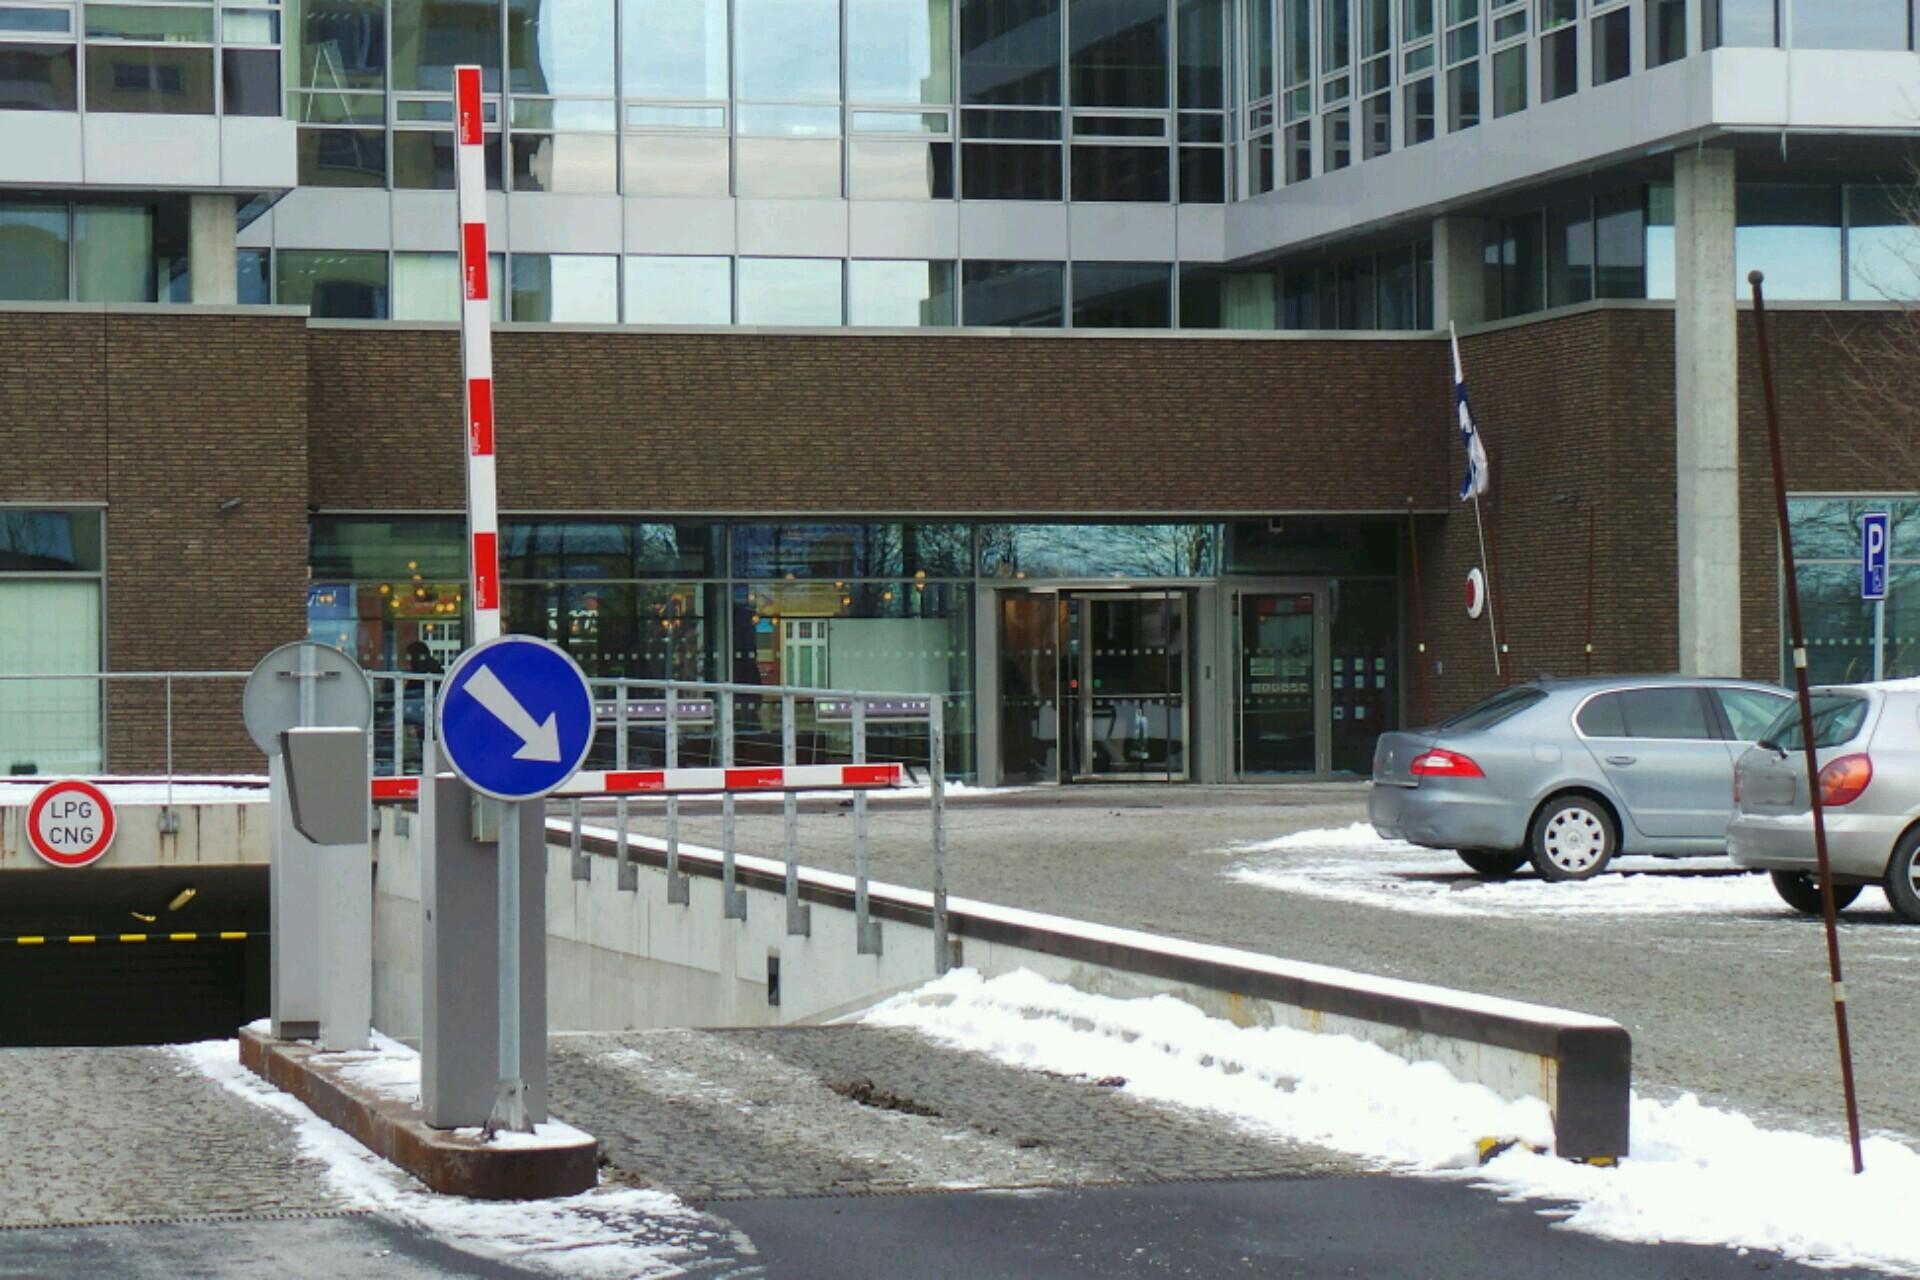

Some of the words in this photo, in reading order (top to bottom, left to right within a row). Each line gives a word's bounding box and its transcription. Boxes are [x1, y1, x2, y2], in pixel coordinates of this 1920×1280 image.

[1868, 523, 1883, 572] P
[51, 801, 92, 818] LPG
[49, 827, 94, 845] CNG
